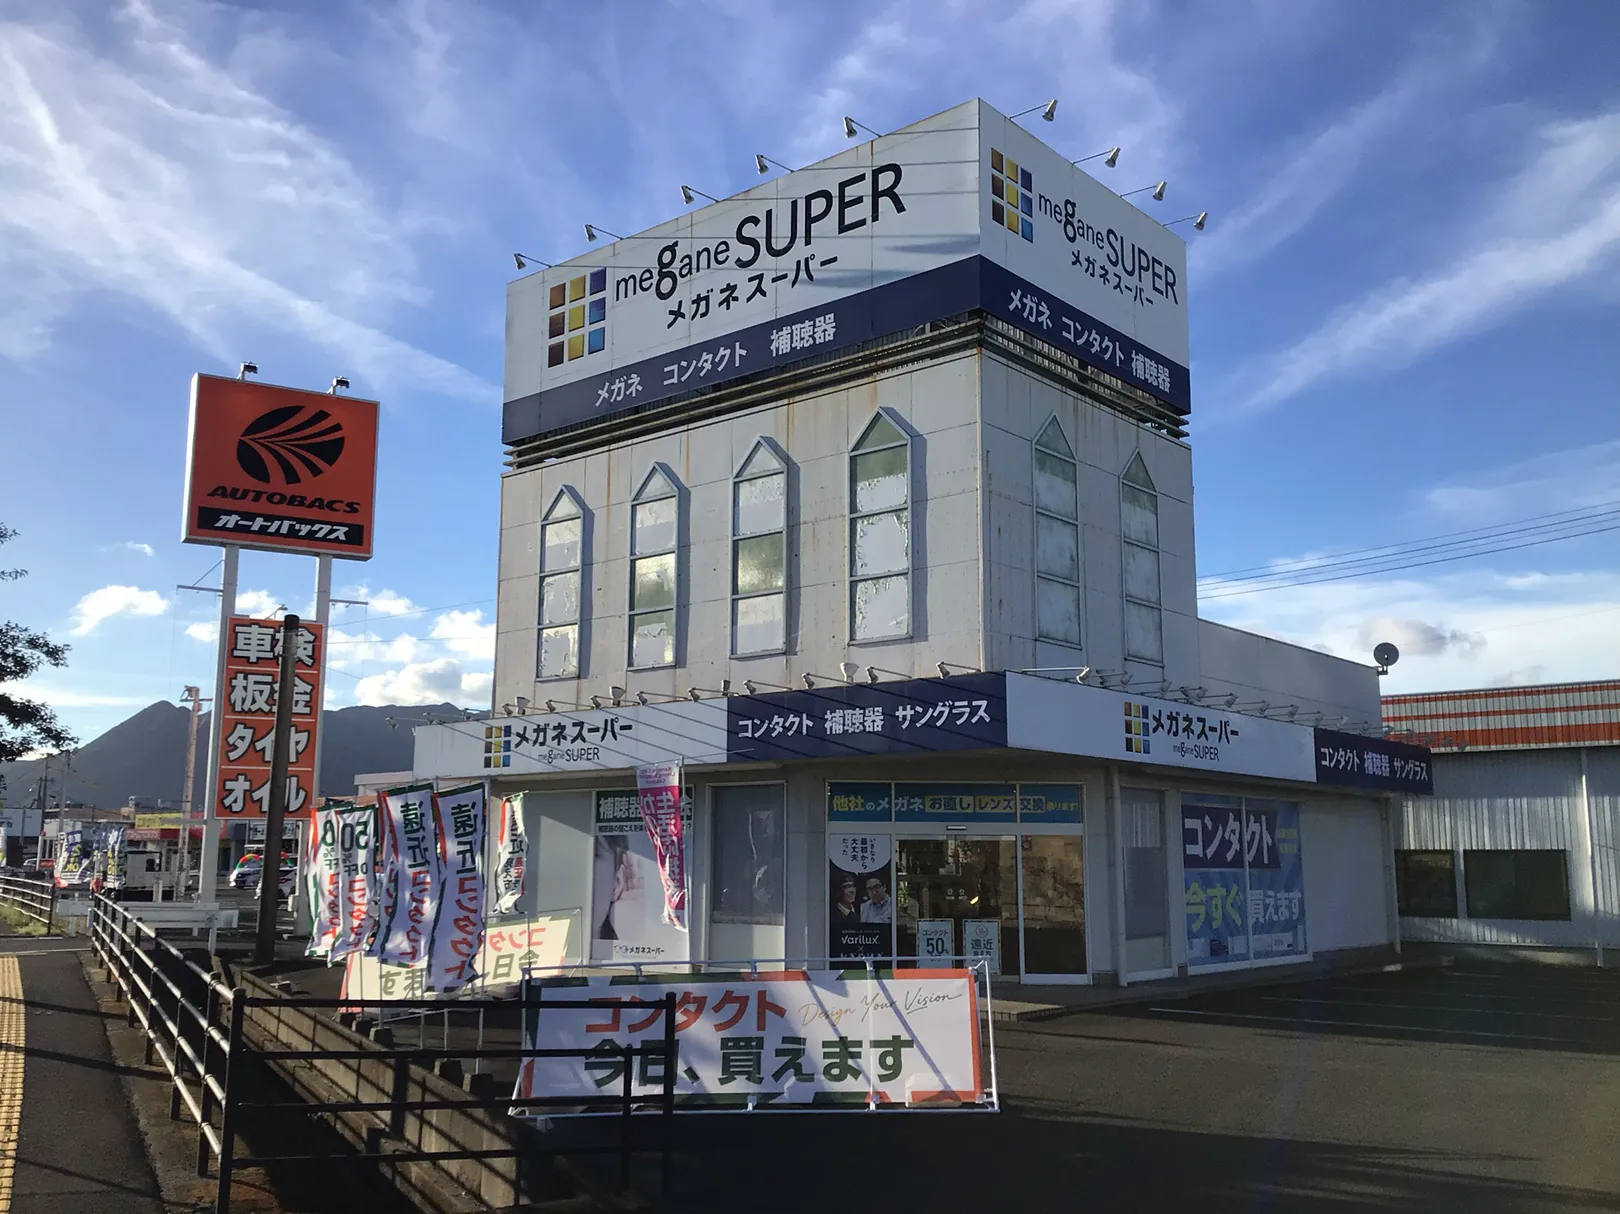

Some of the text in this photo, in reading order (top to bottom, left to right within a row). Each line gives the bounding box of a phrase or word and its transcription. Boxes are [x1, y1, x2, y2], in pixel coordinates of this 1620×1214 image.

[615, 163, 906, 301] meganeSUPER
[1038, 191, 1179, 305] meganeSUPER
[667, 255, 838, 329] メガネスーパー
[1071, 250, 1154, 307] メガネスーパー
[595, 313, 837, 408] メガネ コンタクト 補聴器
[1008, 289, 1171, 394] メガネ コンタクト 補聴器
[207, 485, 361, 514] AUTOBACS
[214, 513, 349, 541] オートバックス
[514, 716, 633, 749] メガネスーパー
[738, 699, 991, 738] コンタクト 補聴器 サングラス
[1152, 708, 1240, 745] メガネスーパー
[226, 723, 310, 763] タイヤ
[1320, 747, 1429, 781] コンタクト 補聴器 サングラス
[222, 774, 307, 813] オイル
[1184, 812, 1273, 864] コンタクト
[1186, 881, 1302, 932] 今すぐ 買えます
[629, 946, 665, 955] メガネスーパー
[841, 934, 880, 945] Varilux
[584, 989, 788, 1034] コンタクト
[797, 986, 964, 1029] Design Your Vision
[584, 1035, 914, 1087] 今日、買えます
